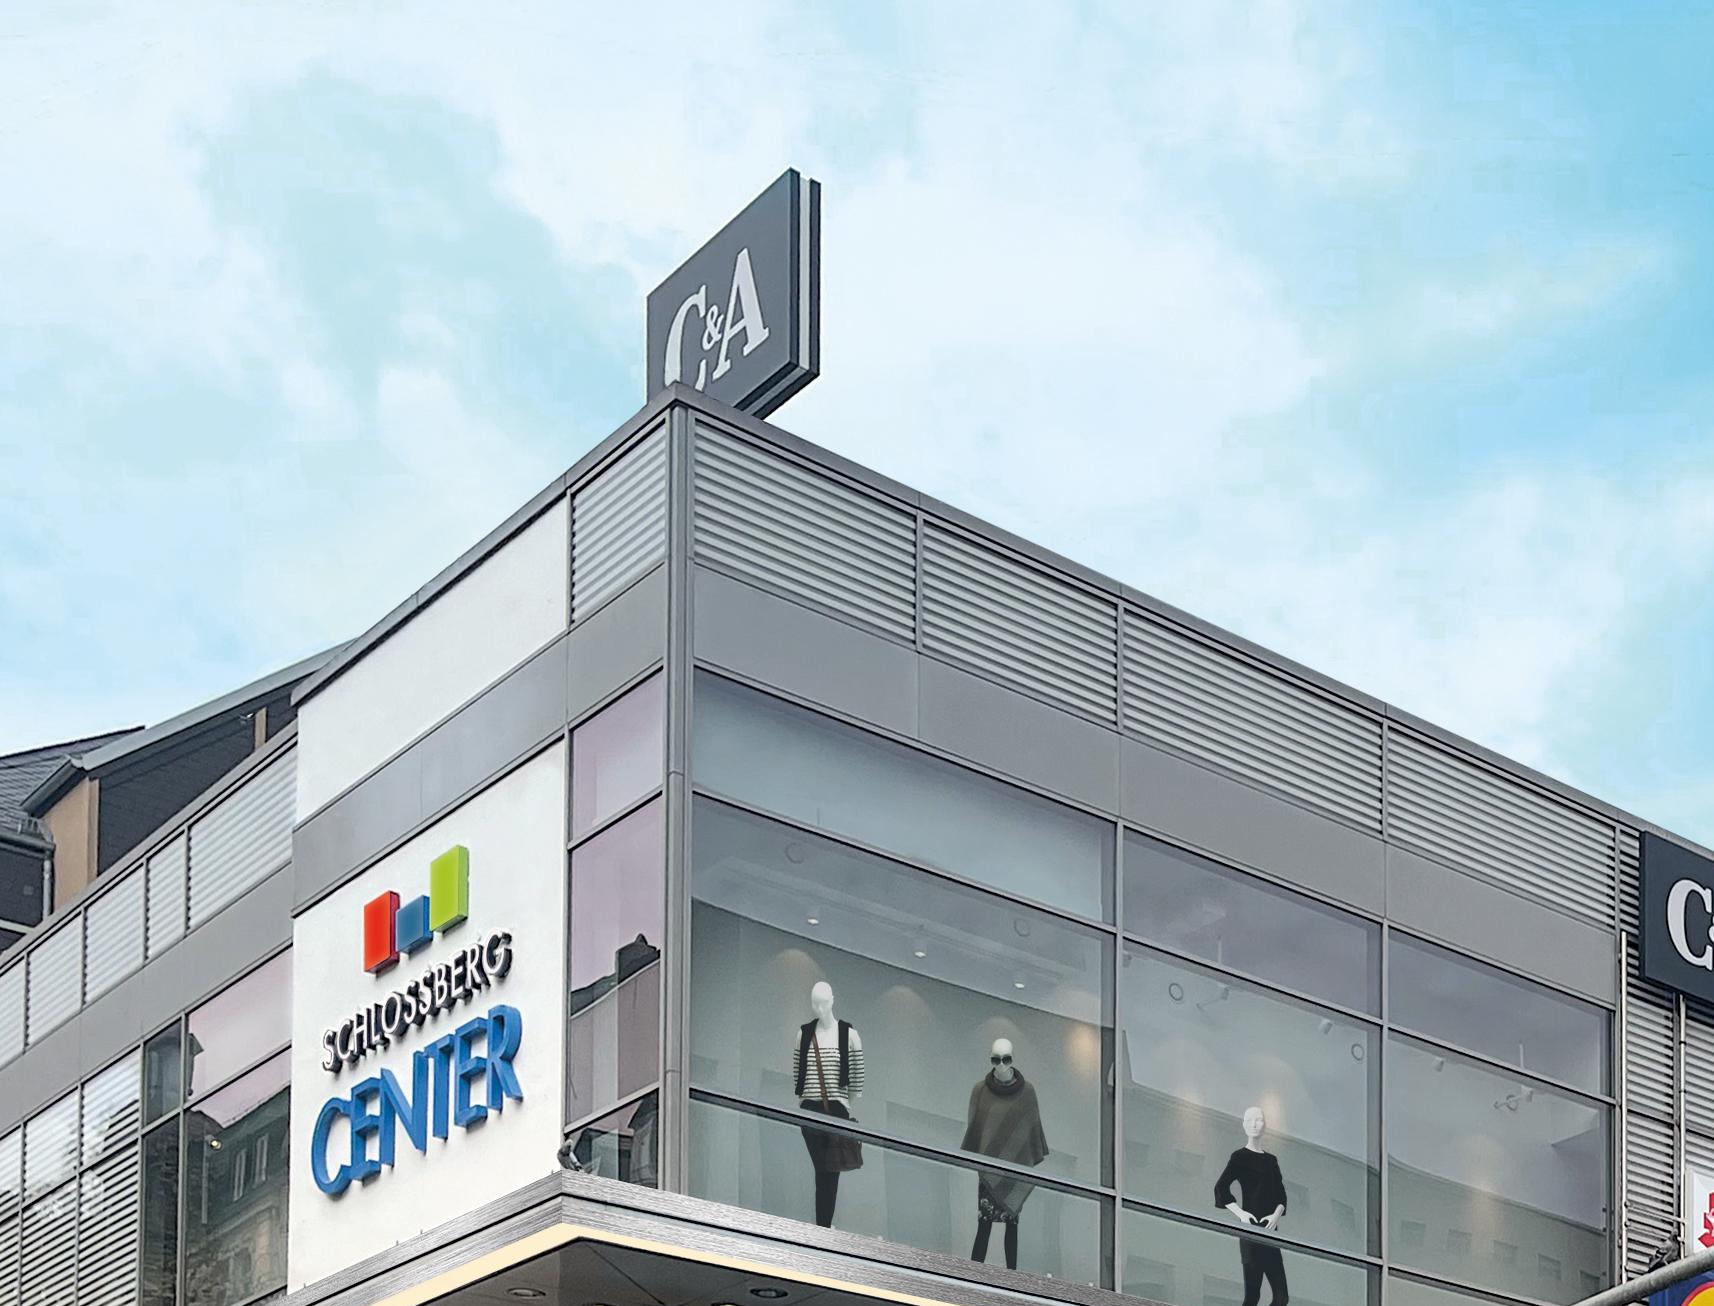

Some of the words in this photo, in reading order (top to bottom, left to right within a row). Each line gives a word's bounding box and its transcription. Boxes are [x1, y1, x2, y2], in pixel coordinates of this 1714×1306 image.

[663, 247, 770, 392] C&A
[322, 928, 512, 1073] SCHLOSSBERG
[311, 1004, 523, 1199] CENTER
